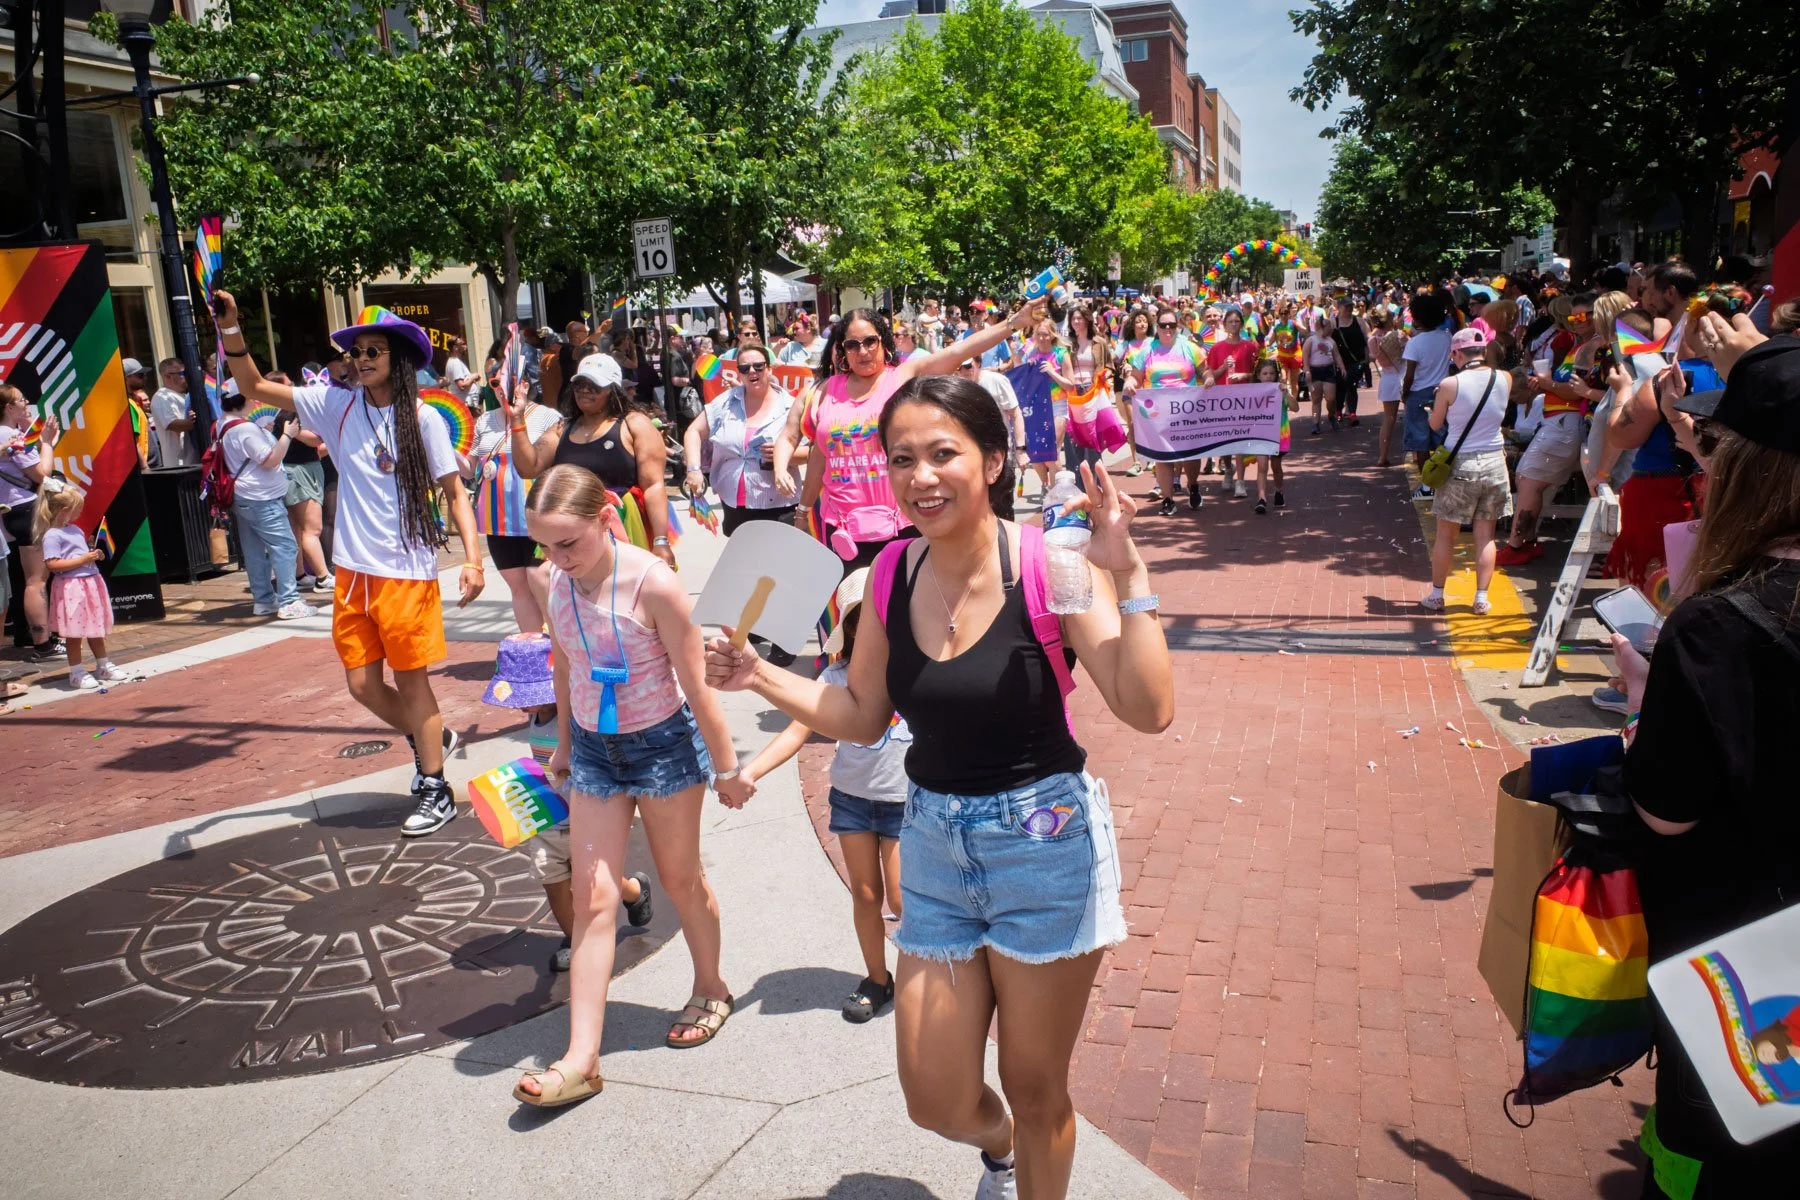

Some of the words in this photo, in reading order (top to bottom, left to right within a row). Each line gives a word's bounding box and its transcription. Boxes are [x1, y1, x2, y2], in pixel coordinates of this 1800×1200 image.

[635, 224, 669, 236] SPEED
[640, 236, 665, 247] LIMIT
[641, 249, 668, 271] 10
[1296, 270, 1311, 280] LOVE
[390, 305, 429, 315] PROPER
[1199, 415, 1237, 425] Women's
[1238, 413, 1275, 422] Hospital
[1169, 428, 1251, 442] deaconess.com/bivf
[830, 457, 845, 468] WE
[848, 455, 868, 467] ARE
[871, 454, 888, 465] AL
[115, 594, 155, 602] everyone.
[487, 765, 549, 834] PRIDE
[230, 1019, 427, 1069] MALL
